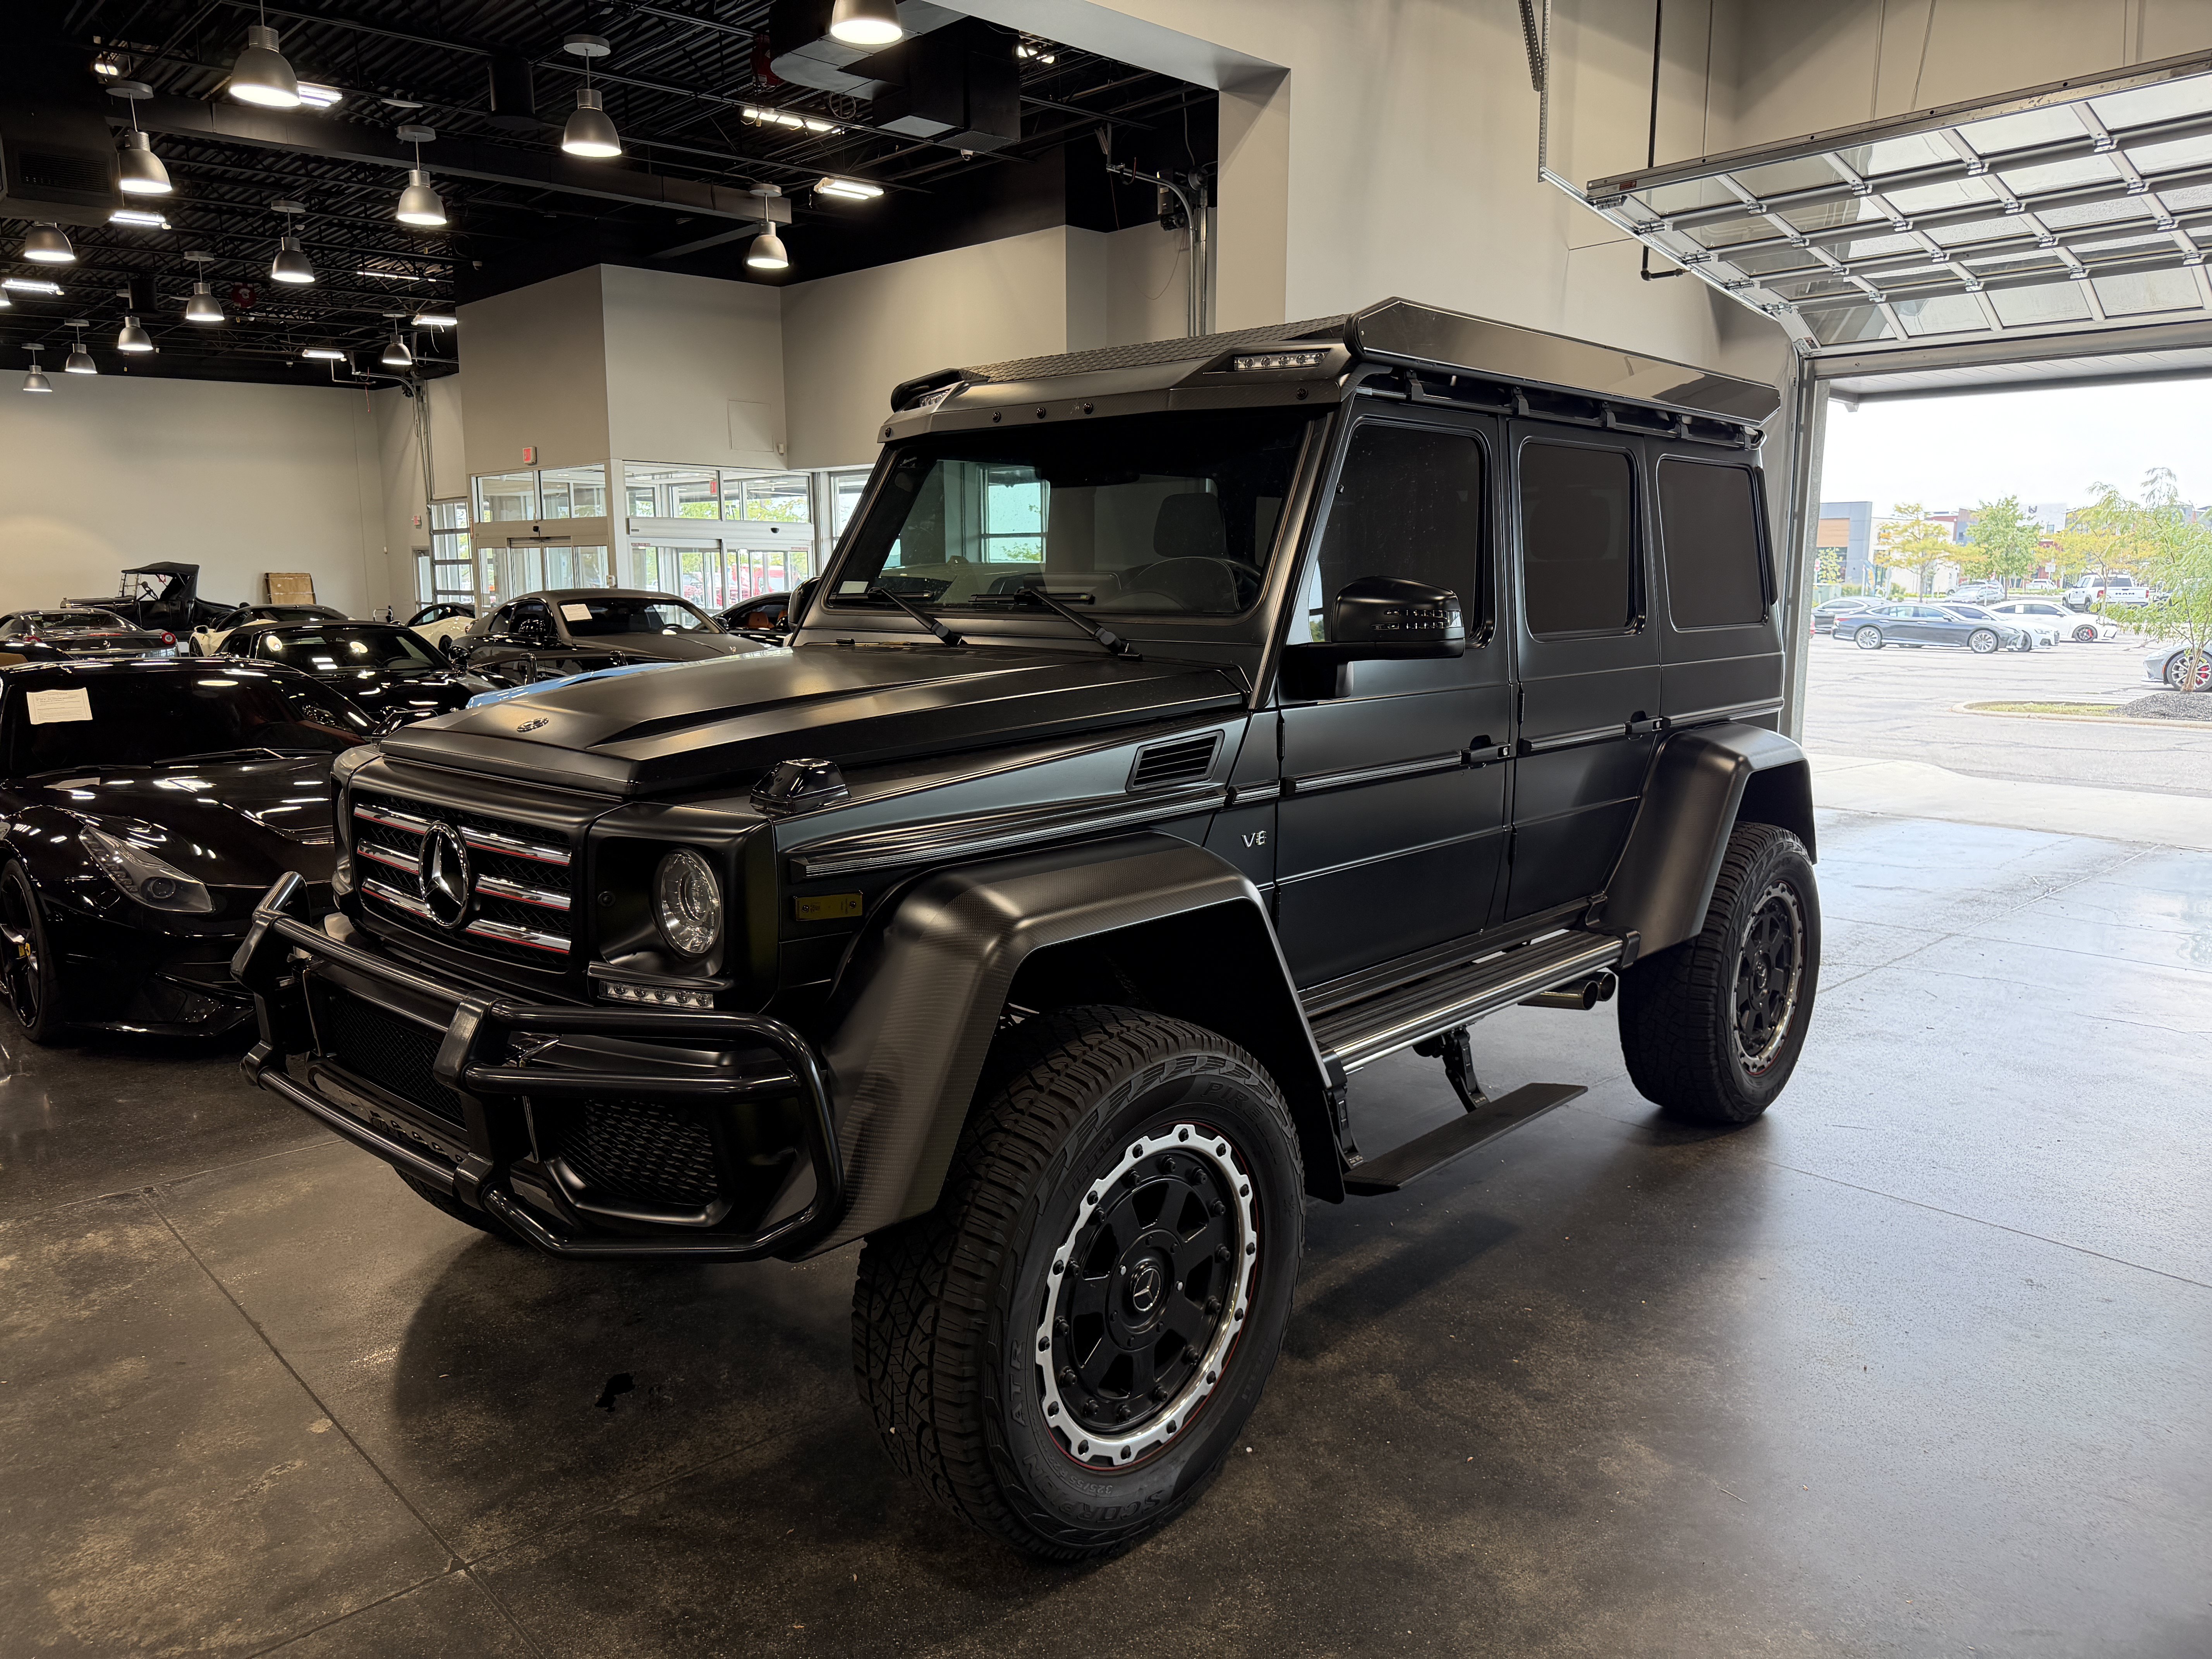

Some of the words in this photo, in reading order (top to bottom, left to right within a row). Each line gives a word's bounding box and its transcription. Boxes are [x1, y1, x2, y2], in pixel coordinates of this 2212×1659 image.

[1200, 1081, 1288, 1165] PIRELLI
[1009, 1339, 1026, 1426] ATR
[1069, 1476, 1113, 1494] 325/55
